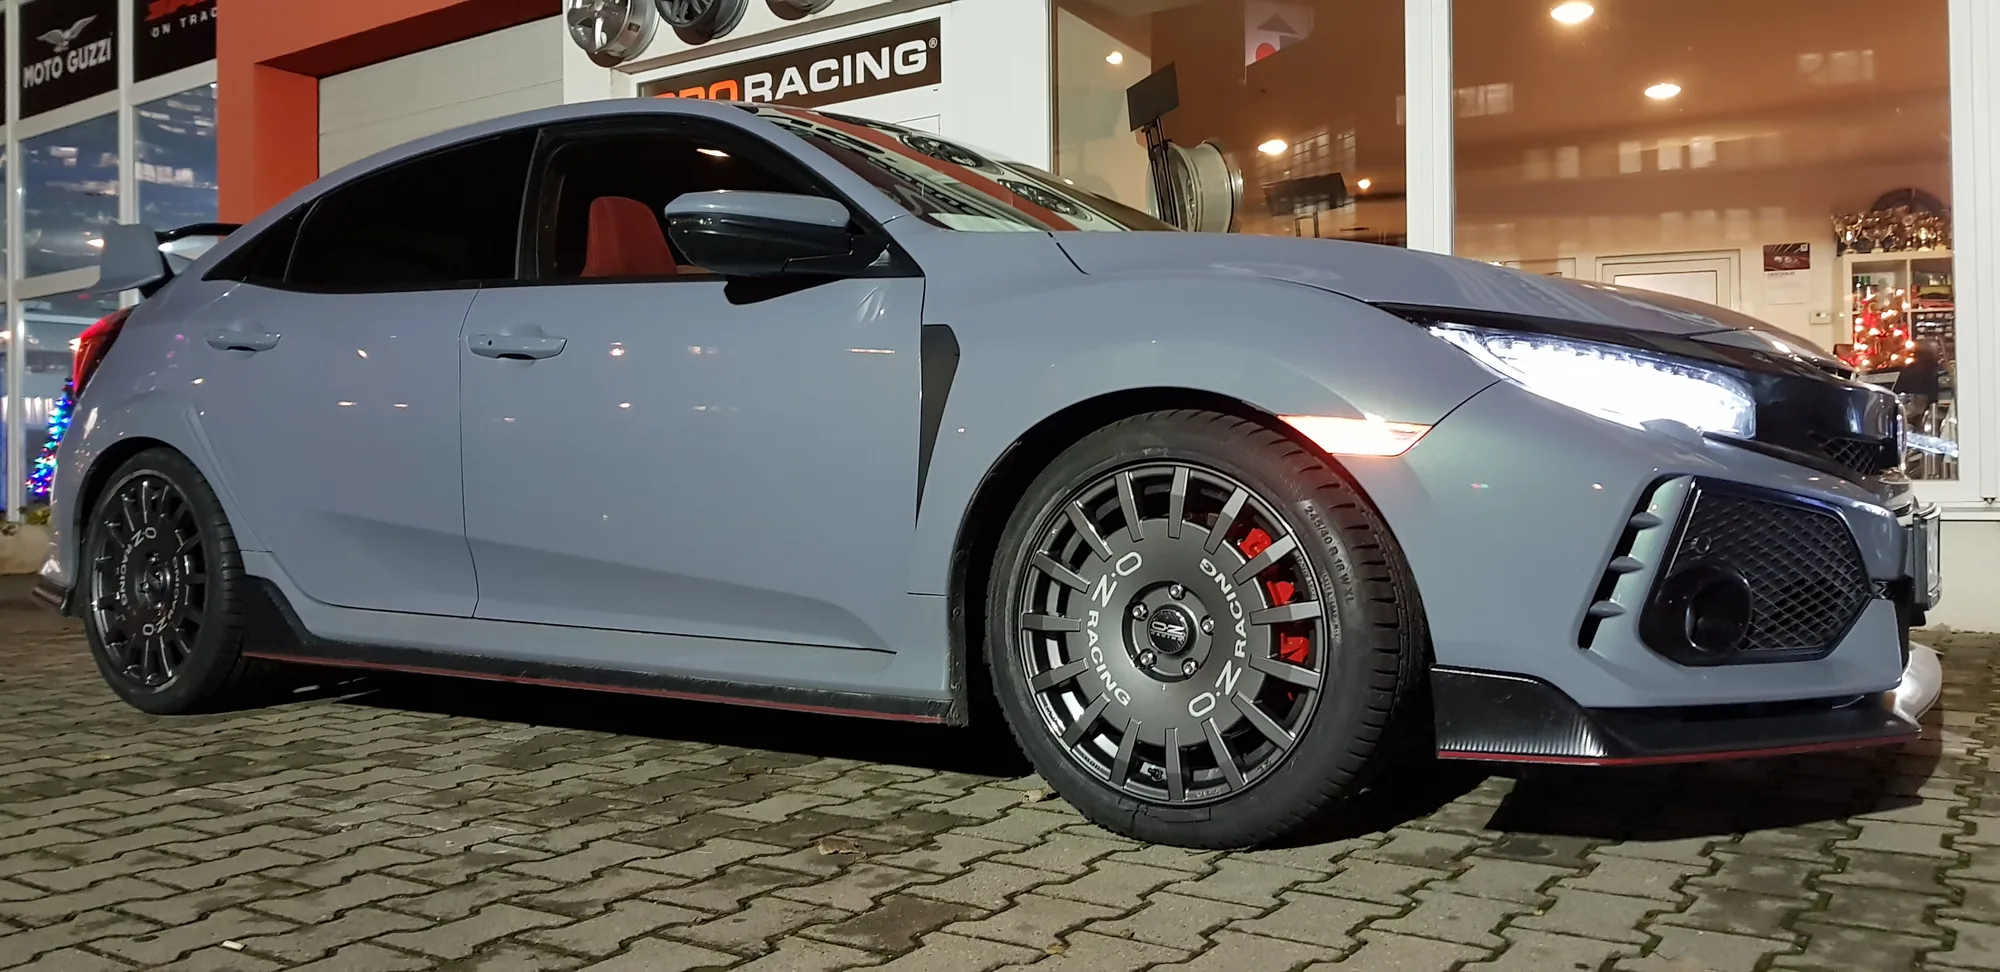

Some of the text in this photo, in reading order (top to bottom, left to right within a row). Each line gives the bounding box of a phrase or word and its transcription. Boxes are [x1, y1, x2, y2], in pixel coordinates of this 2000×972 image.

[23, 38, 111, 88] MOTO GUZZI
[1199, 557, 1247, 658] RACING
[1087, 609, 1131, 707] RACING
